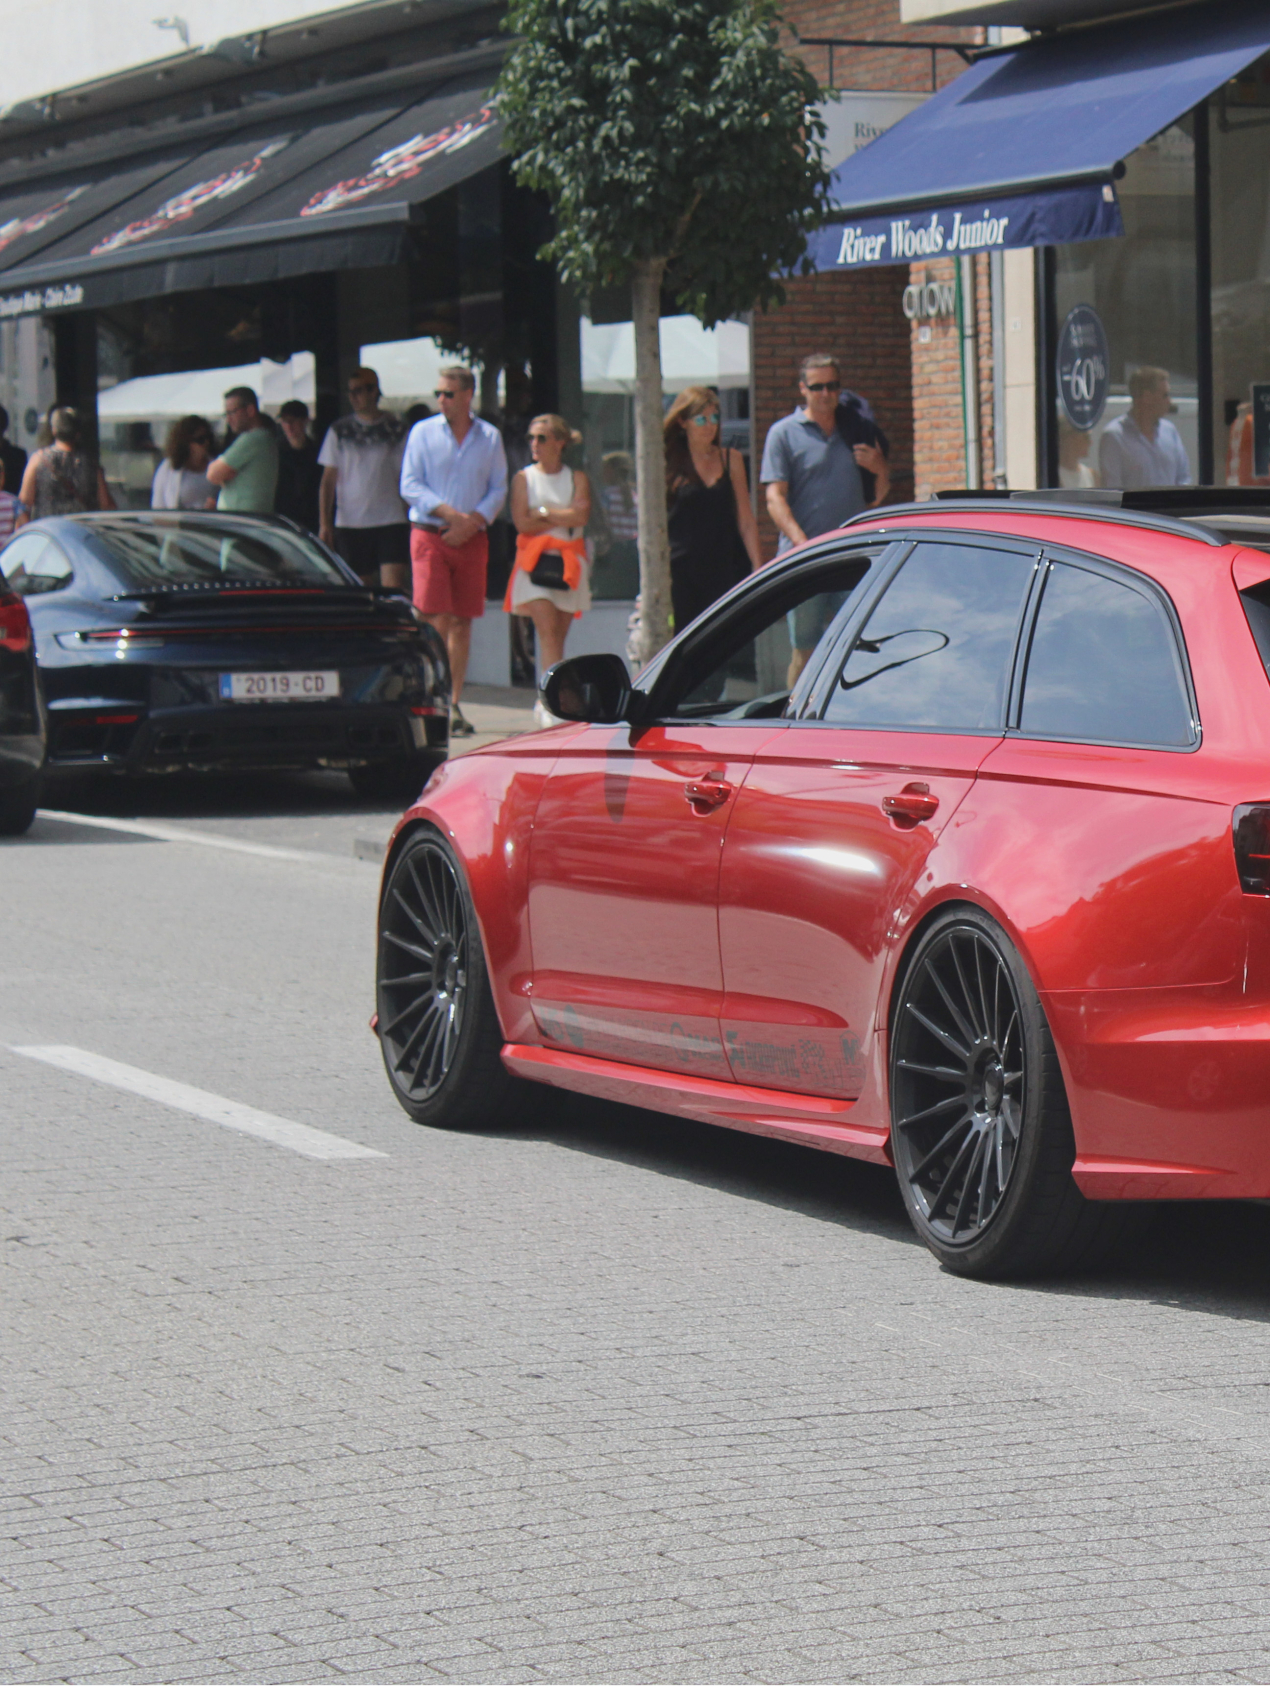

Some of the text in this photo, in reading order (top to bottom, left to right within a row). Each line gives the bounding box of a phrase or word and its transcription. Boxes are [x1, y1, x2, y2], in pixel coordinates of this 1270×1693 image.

[837, 208, 1009, 264] River Woods Junior
